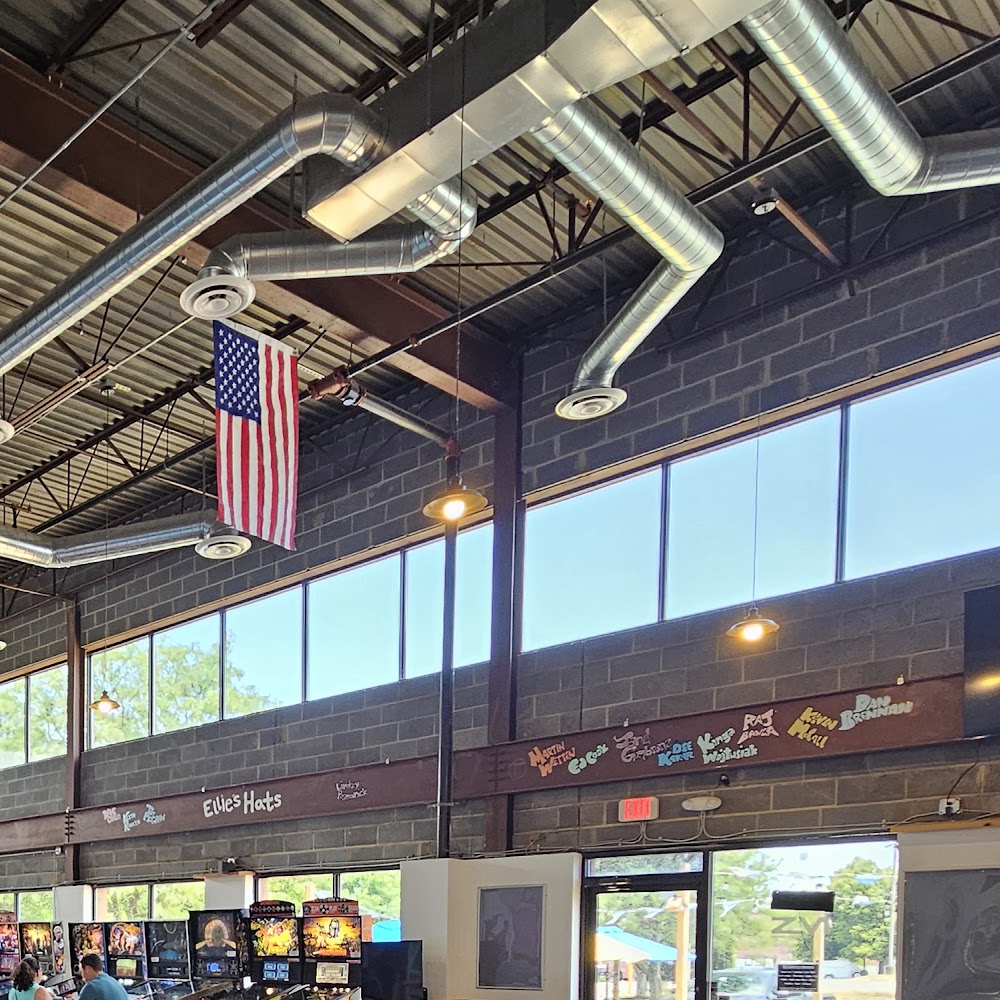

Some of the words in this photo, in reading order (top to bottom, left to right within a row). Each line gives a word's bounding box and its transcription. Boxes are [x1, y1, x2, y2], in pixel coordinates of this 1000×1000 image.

[838, 701, 914, 731] BRENNAN
[855, 694, 892, 713] DAN
[743, 708, 774, 731] RAJ
[528, 741, 566, 767] MARTIN
[203, 793, 242, 818] Ellie's
[243, 790, 282, 815] Hats
